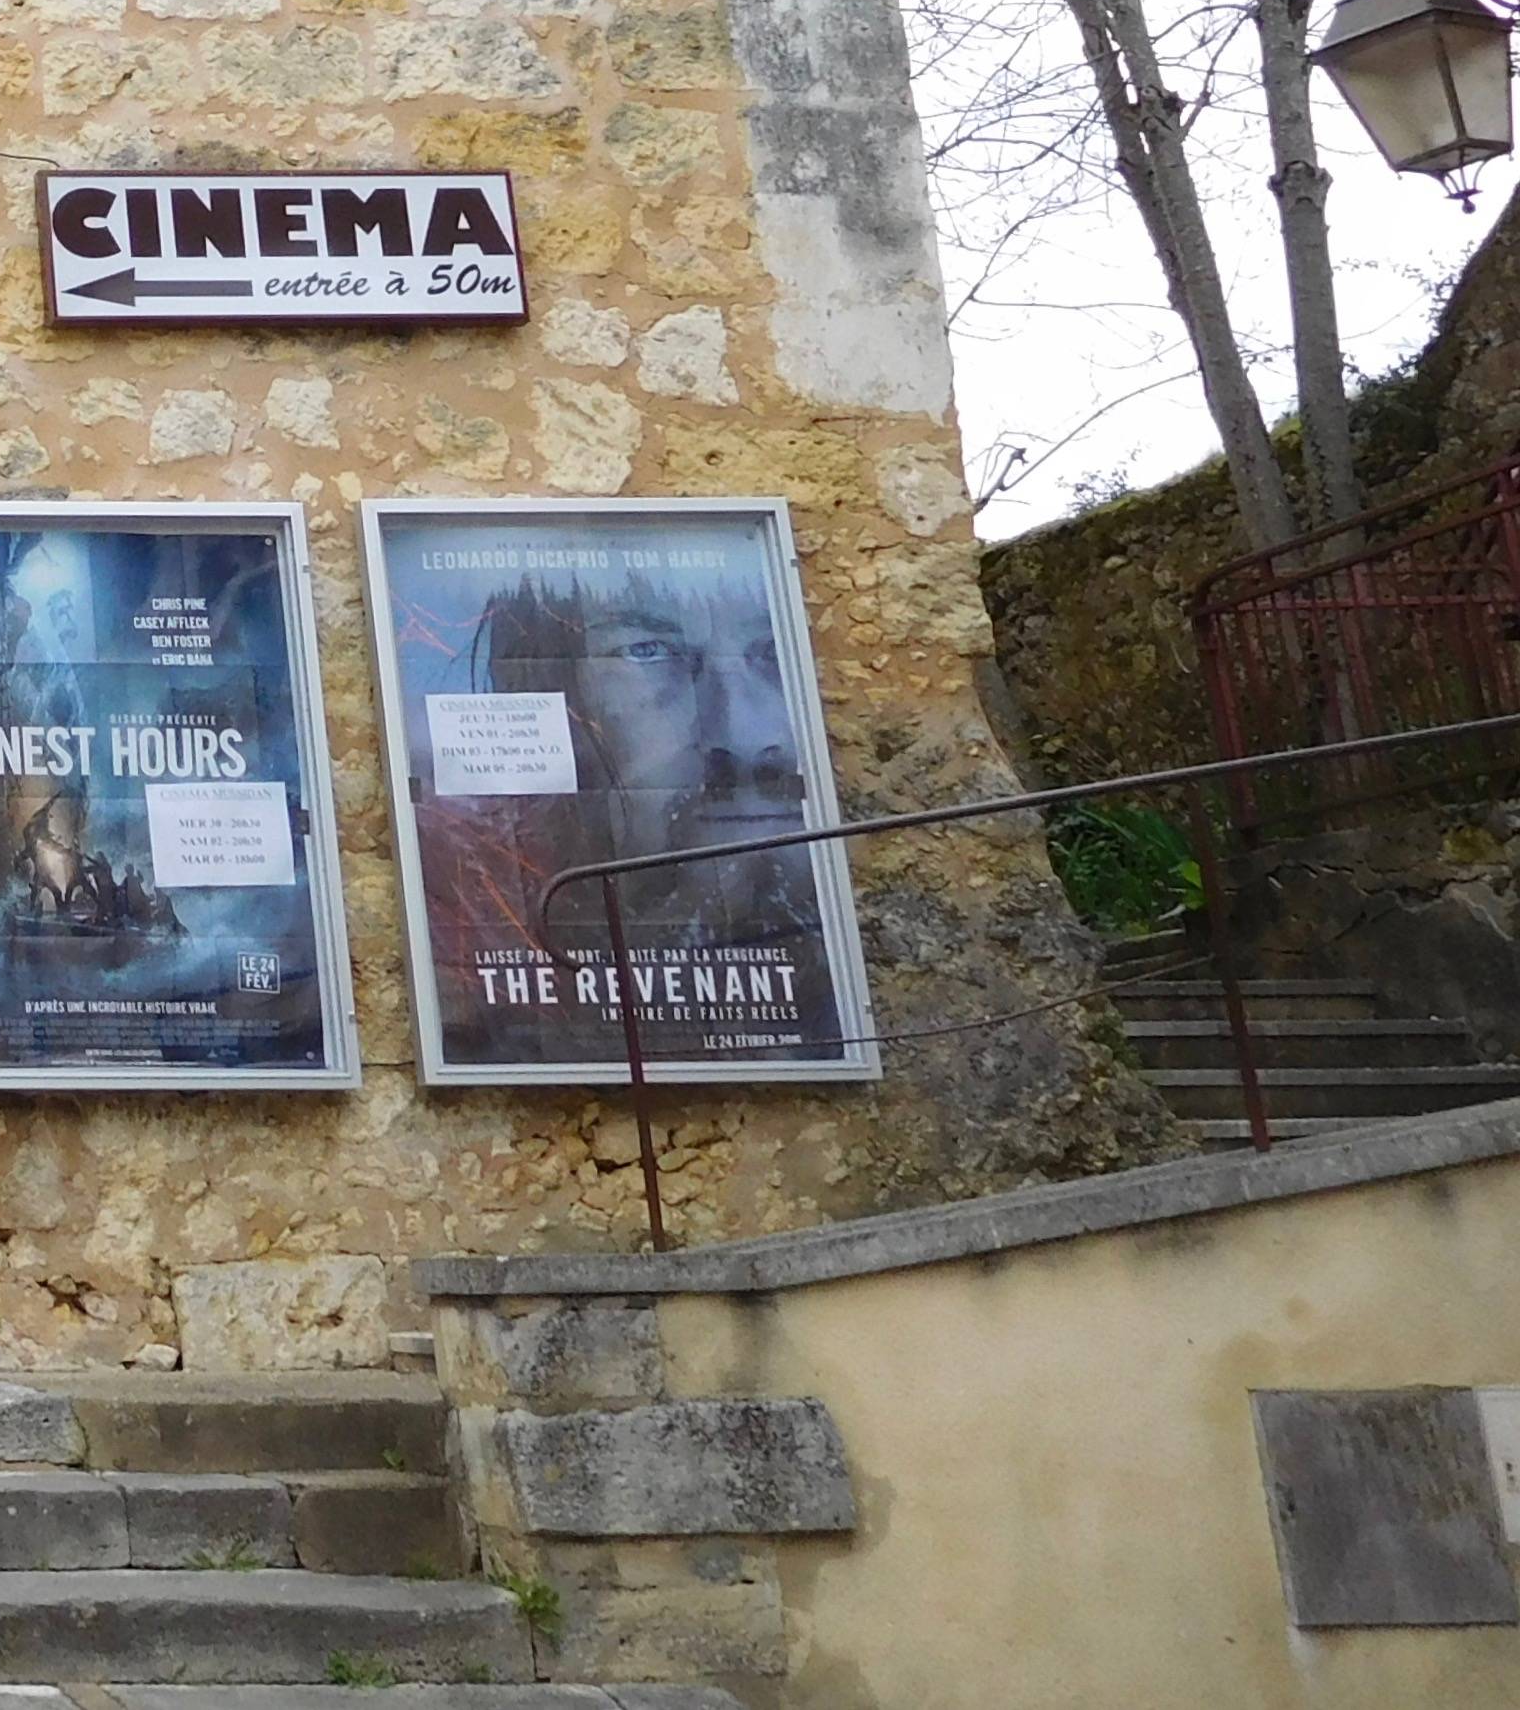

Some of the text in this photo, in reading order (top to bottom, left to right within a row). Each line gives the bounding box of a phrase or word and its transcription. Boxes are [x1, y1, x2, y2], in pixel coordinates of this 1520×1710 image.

[52, 187, 514, 259] CINEMA
[264, 264, 516, 297] entrée à 50m
[422, 551, 518, 571] LEONARDO
[621, 550, 660, 569] TOM
[668, 550, 726, 568] HARDY
[152, 598, 207, 611] CHRIS PINE
[133, 616, 209, 629] CASEY AFFLECK
[151, 634, 212, 648] BEN FOSTER
[161, 653, 185, 665] ERIC
[186, 653, 214, 666] BANA
[110, 714, 152, 725] DISNEY
[112, 727, 246, 777] HOURS
[663, 949, 689, 963] PAR
[694, 949, 710, 962] LA
[715, 948, 794, 962] VENGEANCE.
[242, 956, 275, 972] LE 24
[246, 970, 272, 989] FÉV.
[477, 965, 796, 1004] THE REVENANT
[25, 999, 216, 1014] D'APRÈS UNE INCROYABLE HISTOIRE VRAIE
[673, 1007, 691, 1021] DE
[700, 1006, 744, 1021] FAITS
[751, 1005, 798, 1021] RÉELS
[704, 1034, 717, 1049] LE
[718, 1034, 733, 1048] 24
